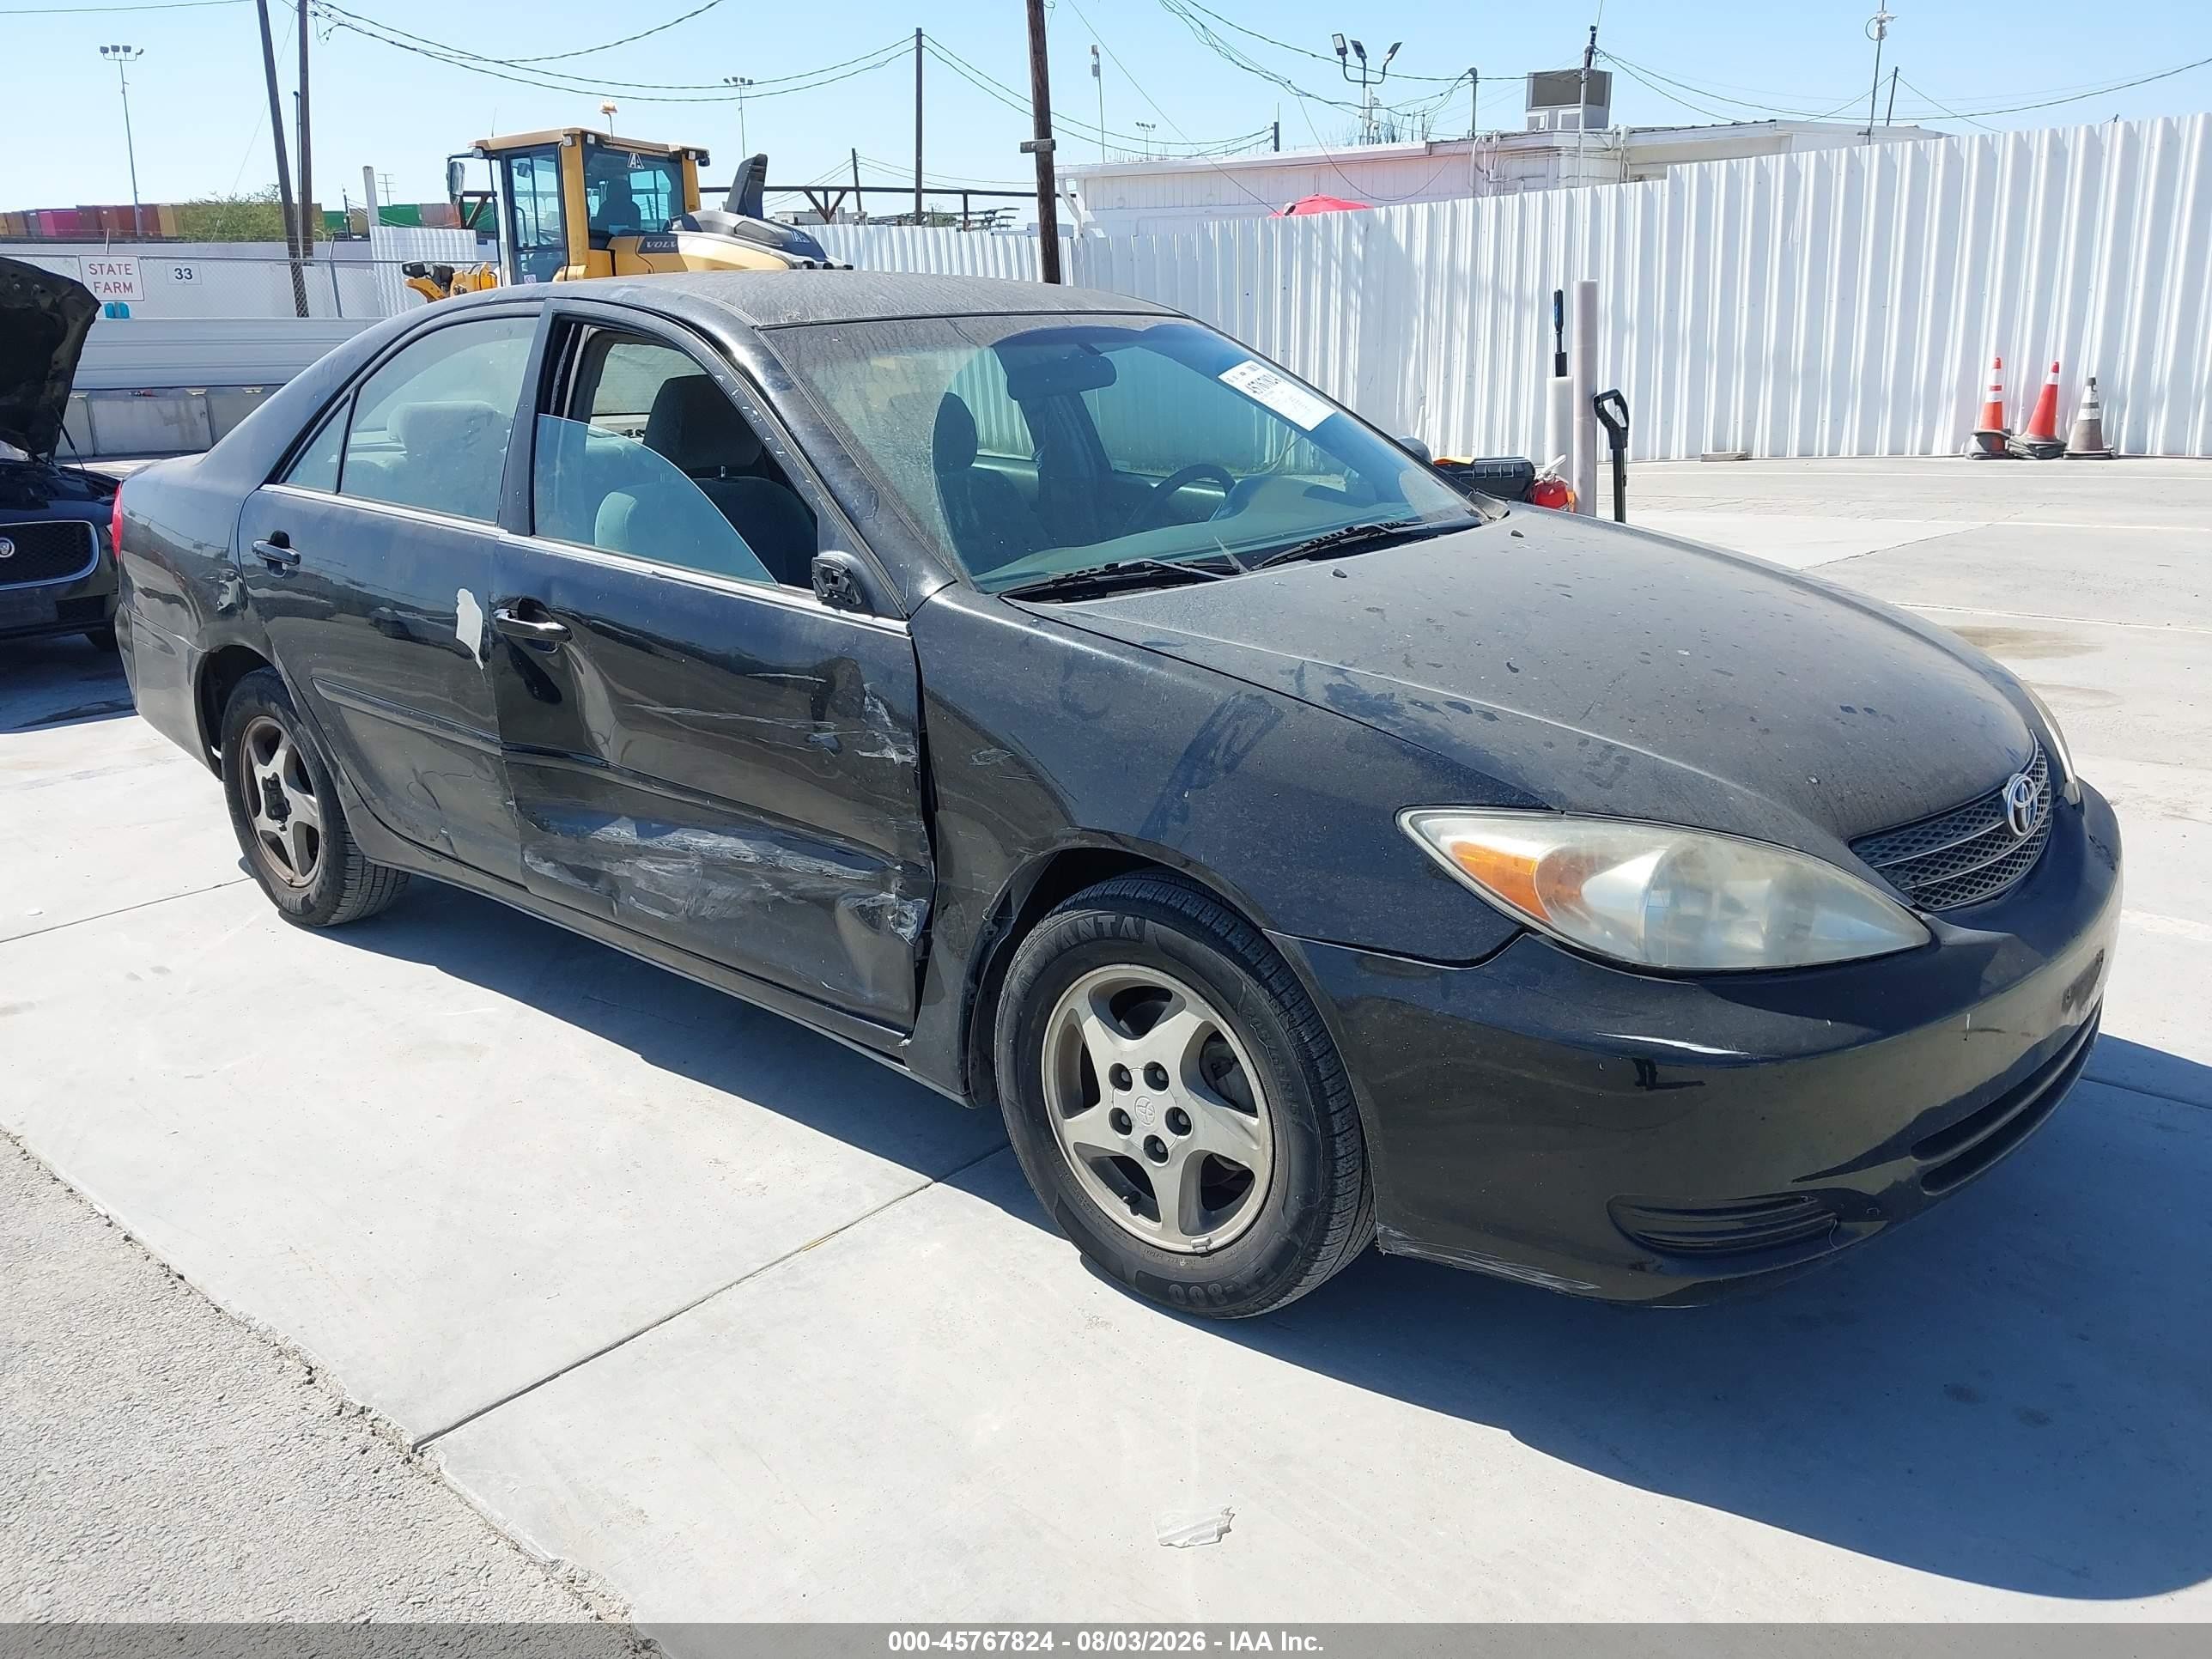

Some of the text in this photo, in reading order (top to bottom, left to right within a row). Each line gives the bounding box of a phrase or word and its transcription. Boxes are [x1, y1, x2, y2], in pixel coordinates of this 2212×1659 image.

[88, 264, 132, 275] STATE
[173, 267, 193, 280] 33
[94, 282, 133, 293] FARM
